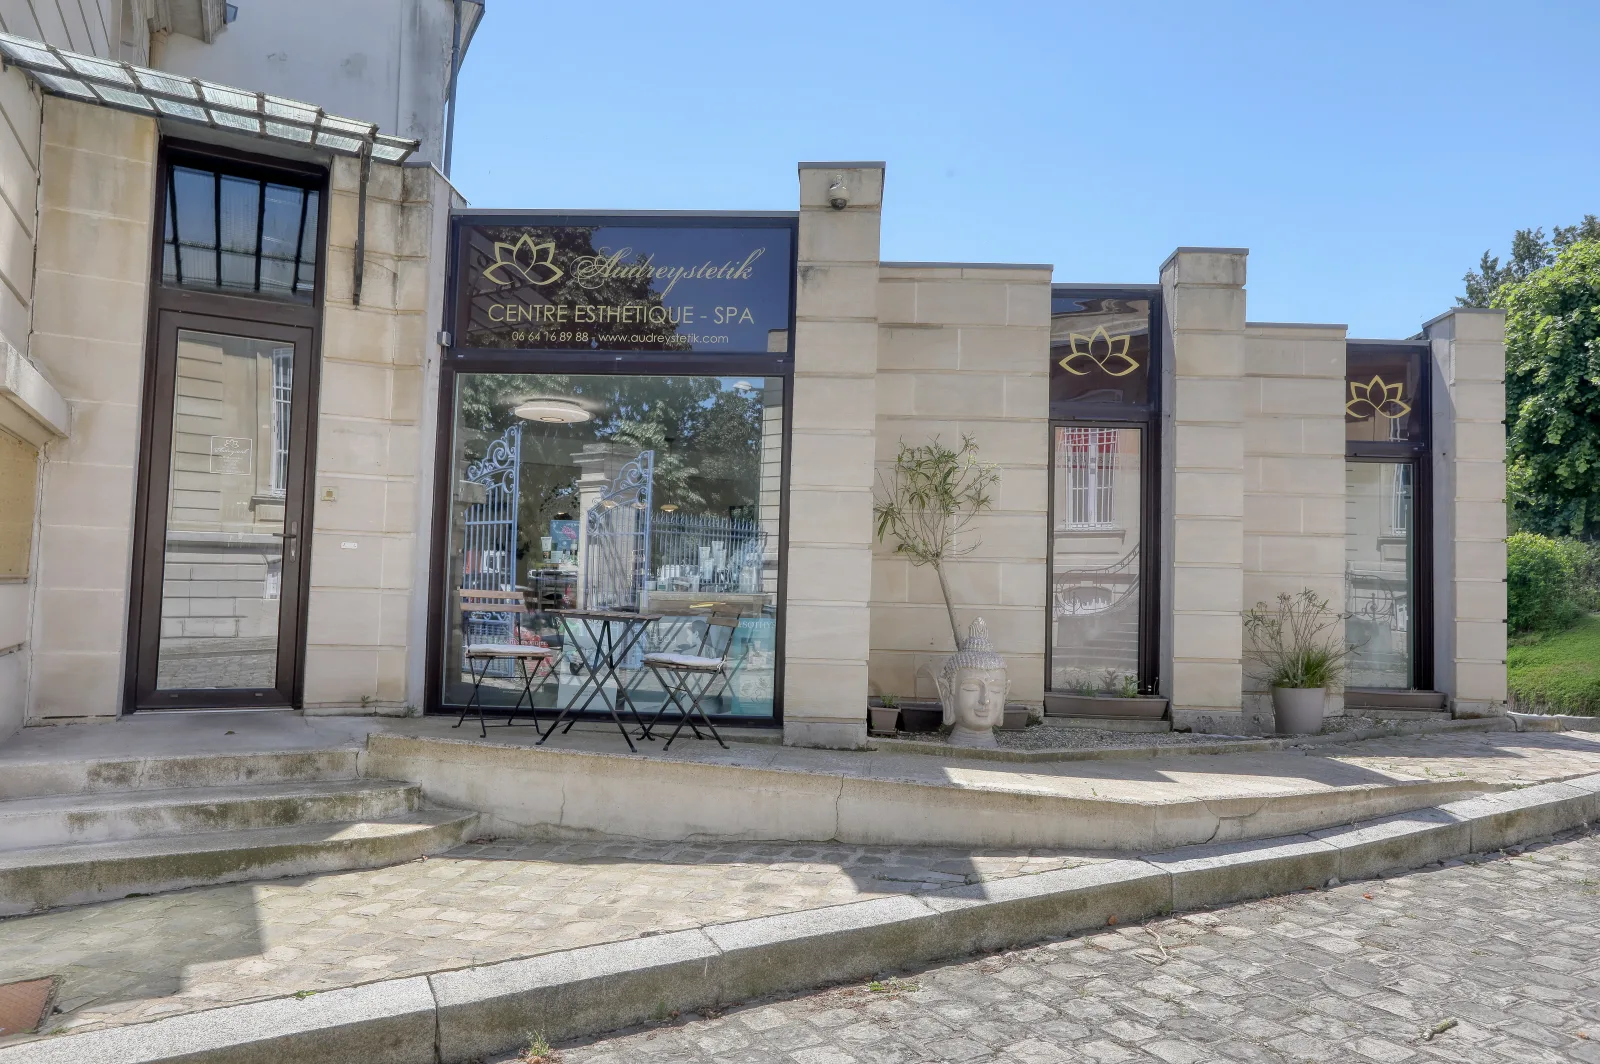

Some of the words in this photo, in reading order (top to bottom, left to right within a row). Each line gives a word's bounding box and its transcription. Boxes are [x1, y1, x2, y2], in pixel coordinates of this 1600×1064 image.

[488, 303, 568, 323] CENTRE
[574, 301, 694, 325] ESTHÉTIQUE
[713, 306, 755, 325] SPA
[511, 331, 525, 342] 06
[528, 331, 541, 342] 64
[545, 332, 557, 342] 16
[559, 331, 573, 342] 89
[575, 332, 589, 342] 88
[598, 332, 729, 345] www.audreystetik.com
